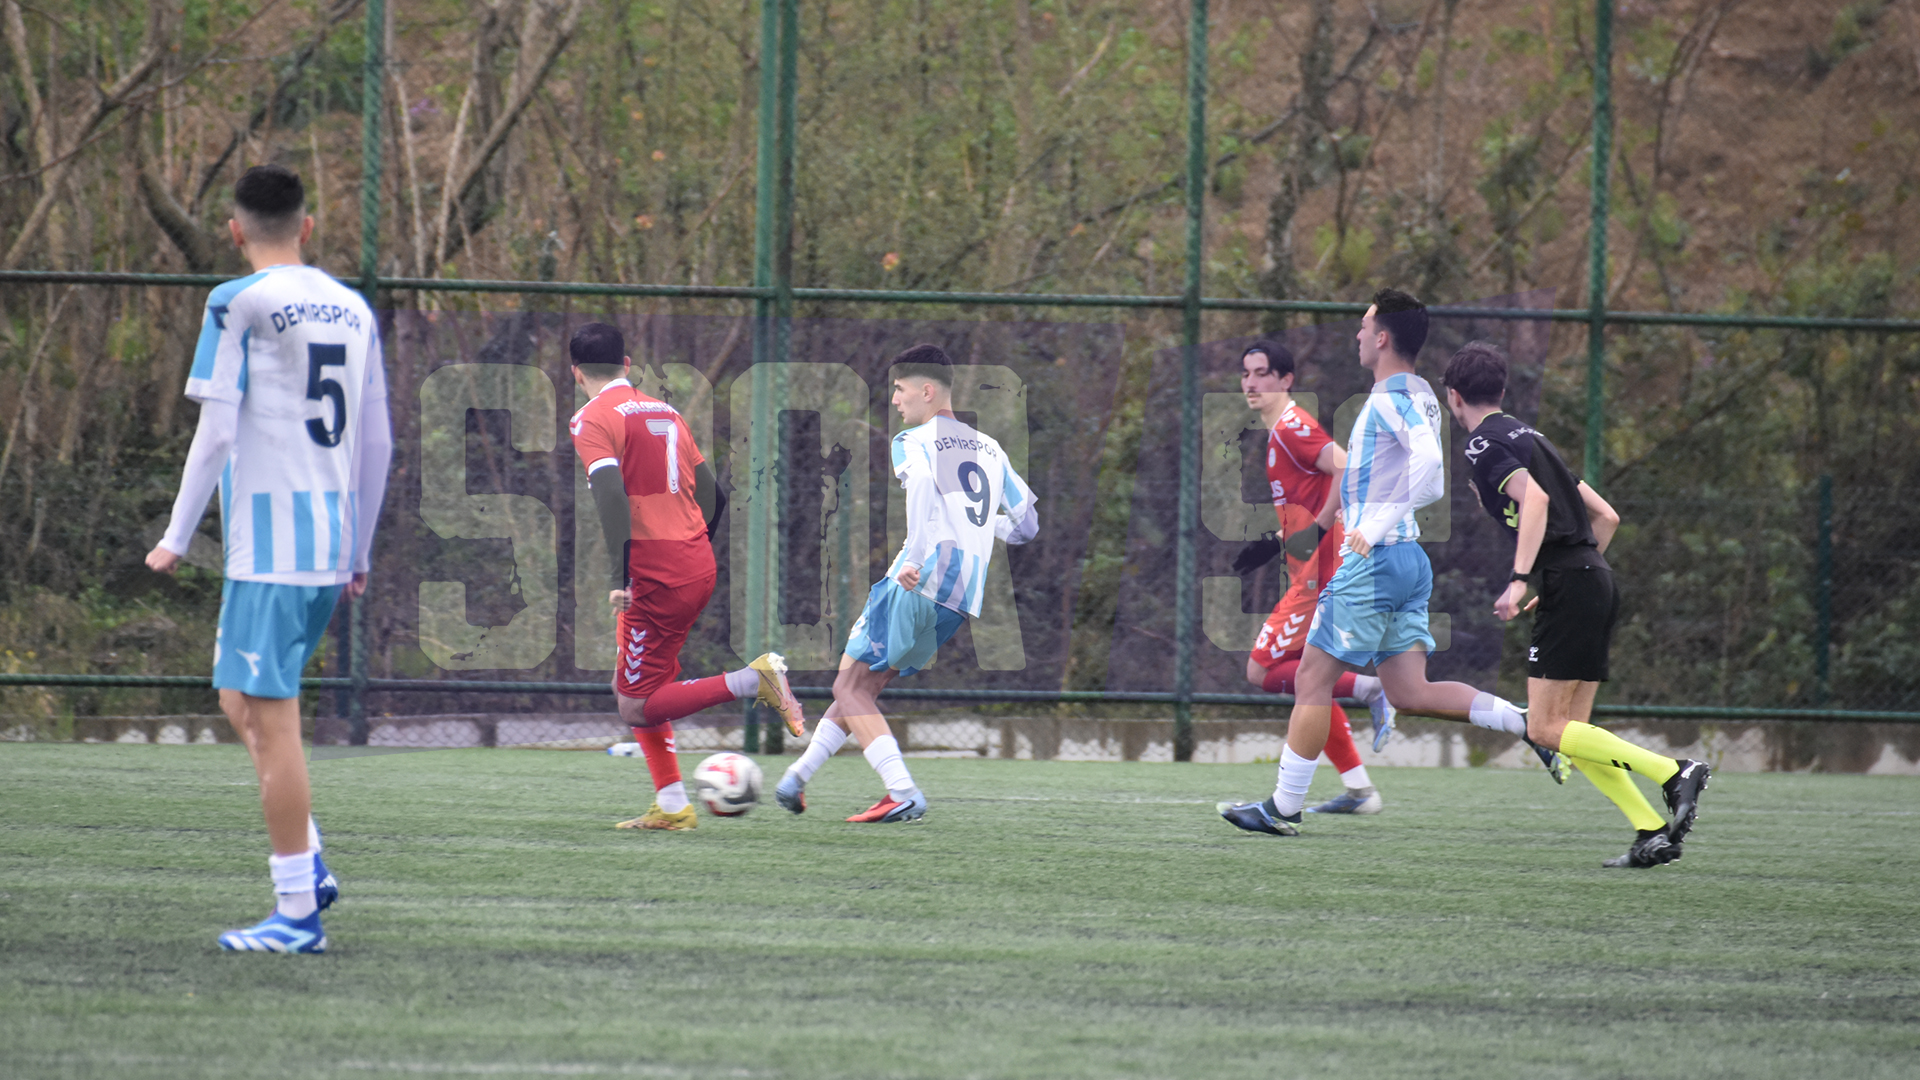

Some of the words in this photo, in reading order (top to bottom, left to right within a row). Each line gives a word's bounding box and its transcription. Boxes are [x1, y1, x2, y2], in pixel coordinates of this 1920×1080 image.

[270, 299, 362, 334] DEMİRSPOR
[305, 342, 346, 448] 5
[645, 418, 680, 494] 7
[934, 435, 998, 461] DEMİRSPOR
[957, 460, 991, 527] 9
